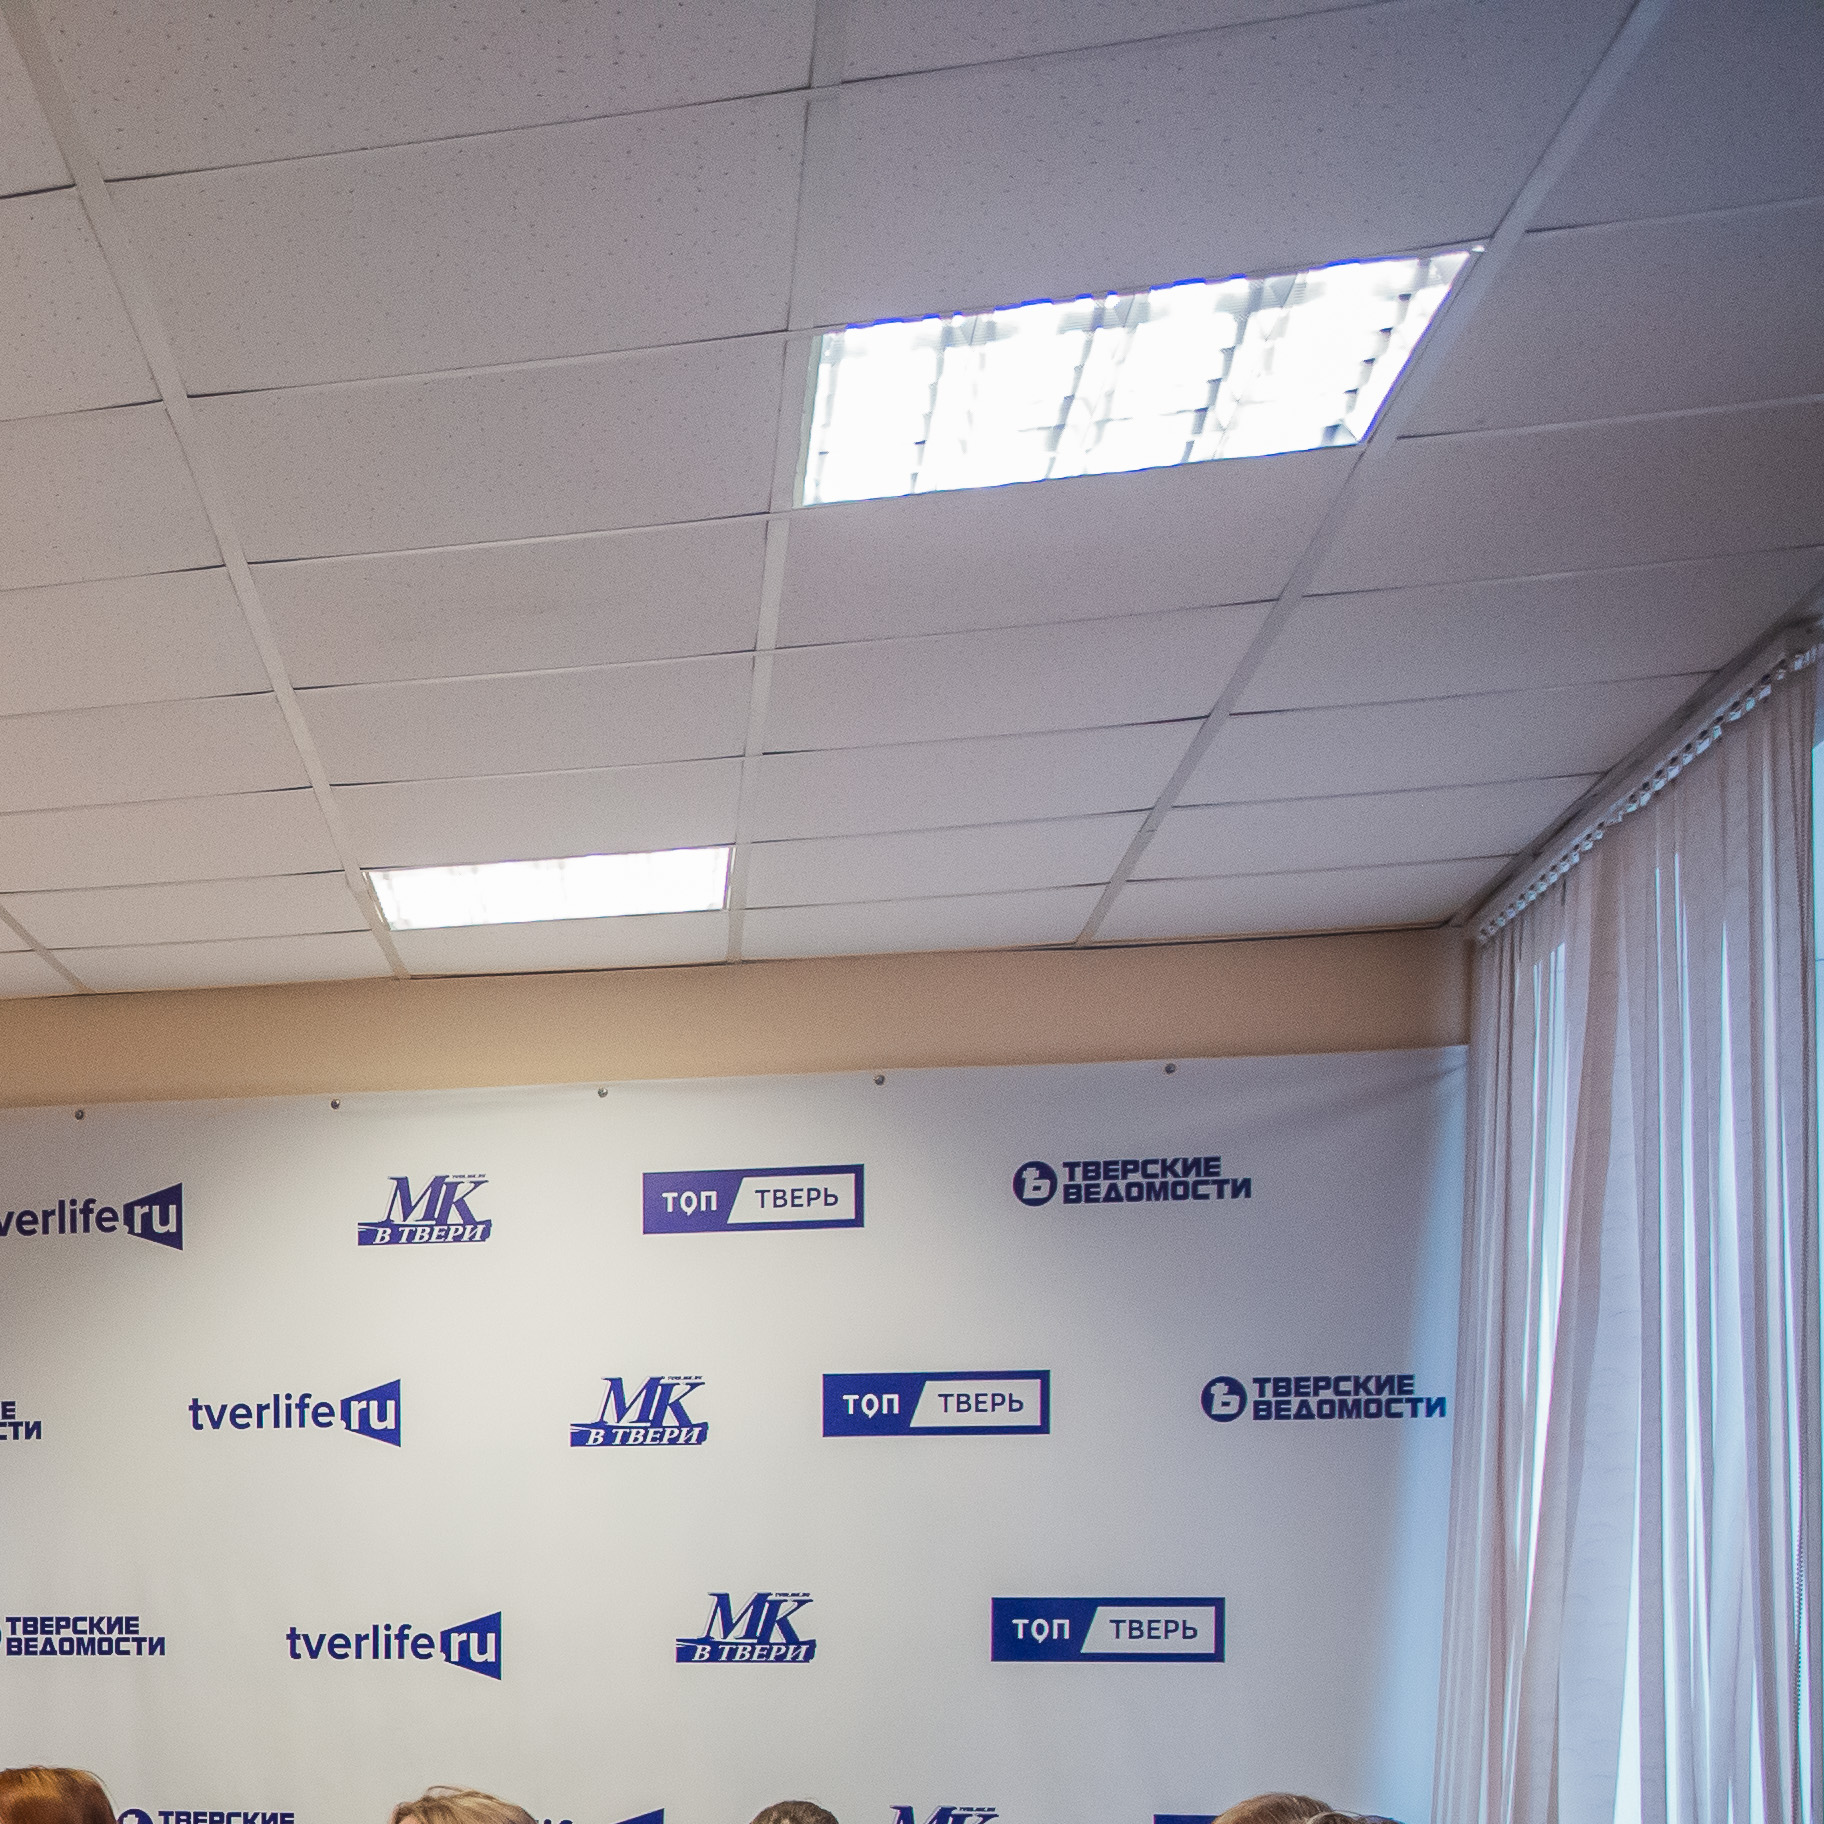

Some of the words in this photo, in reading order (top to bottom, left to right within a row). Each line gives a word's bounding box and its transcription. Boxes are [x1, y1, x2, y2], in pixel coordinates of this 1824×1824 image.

[1062, 1157, 1221, 1181] ТВЕРСКИЕ
[387, 1174, 489, 1225] МК
[662, 1191, 717, 1215] ТОП
[755, 1188, 838, 1208] ТВЕРЬ
[1063, 1178, 1251, 1204] ВЕДОМОСТИ
[373, 1227, 392, 1244] В
[399, 1224, 486, 1243] ТВЕРИ
[1252, 1374, 1415, 1397] ТВЕРСКИЕ
[601, 1376, 705, 1428] МК
[843, 1394, 898, 1418] ТОП
[938, 1393, 1023, 1412] ТВЕРЬ
[1253, 1397, 1445, 1420] ВЕДОМОСТИ
[585, 1429, 605, 1446] В
[612, 1427, 702, 1445] ТВЕРИ
[6, 1616, 139, 1635] ТВЕРСКИЕ
[709, 1592, 815, 1645] МК
[1012, 1619, 1069, 1643] ТОП
[1110, 1620, 1197, 1639] ТВЕРЬ
[7, 1637, 165, 1655] ВЕДОМОСТИ
[692, 1645, 714, 1663] В
[720, 1644, 812, 1663] ТВЕРИ
